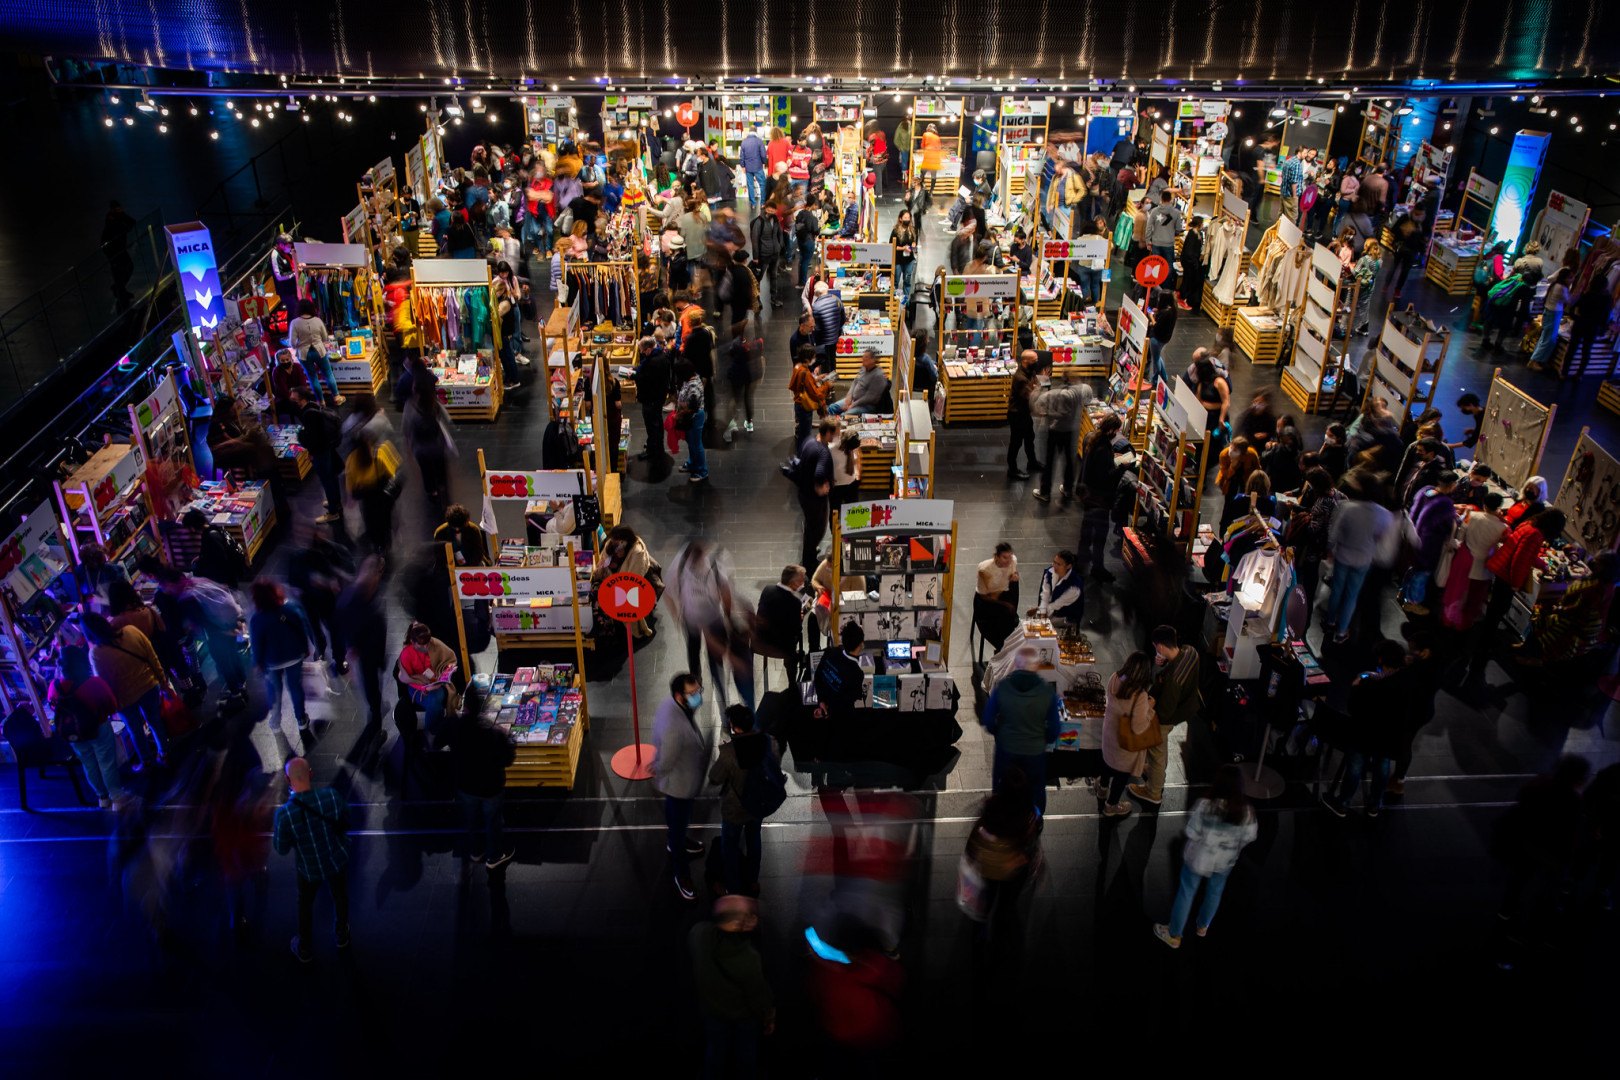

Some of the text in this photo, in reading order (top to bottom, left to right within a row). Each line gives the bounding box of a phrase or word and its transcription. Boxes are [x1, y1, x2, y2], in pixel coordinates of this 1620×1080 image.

[1006, 116, 1029, 126] MICA
[1006, 128, 1028, 140] MICA
[177, 242, 210, 254] MICA
[1142, 257, 1165, 266] EDITORIAL
[606, 575, 647, 589] EDITORIAL
